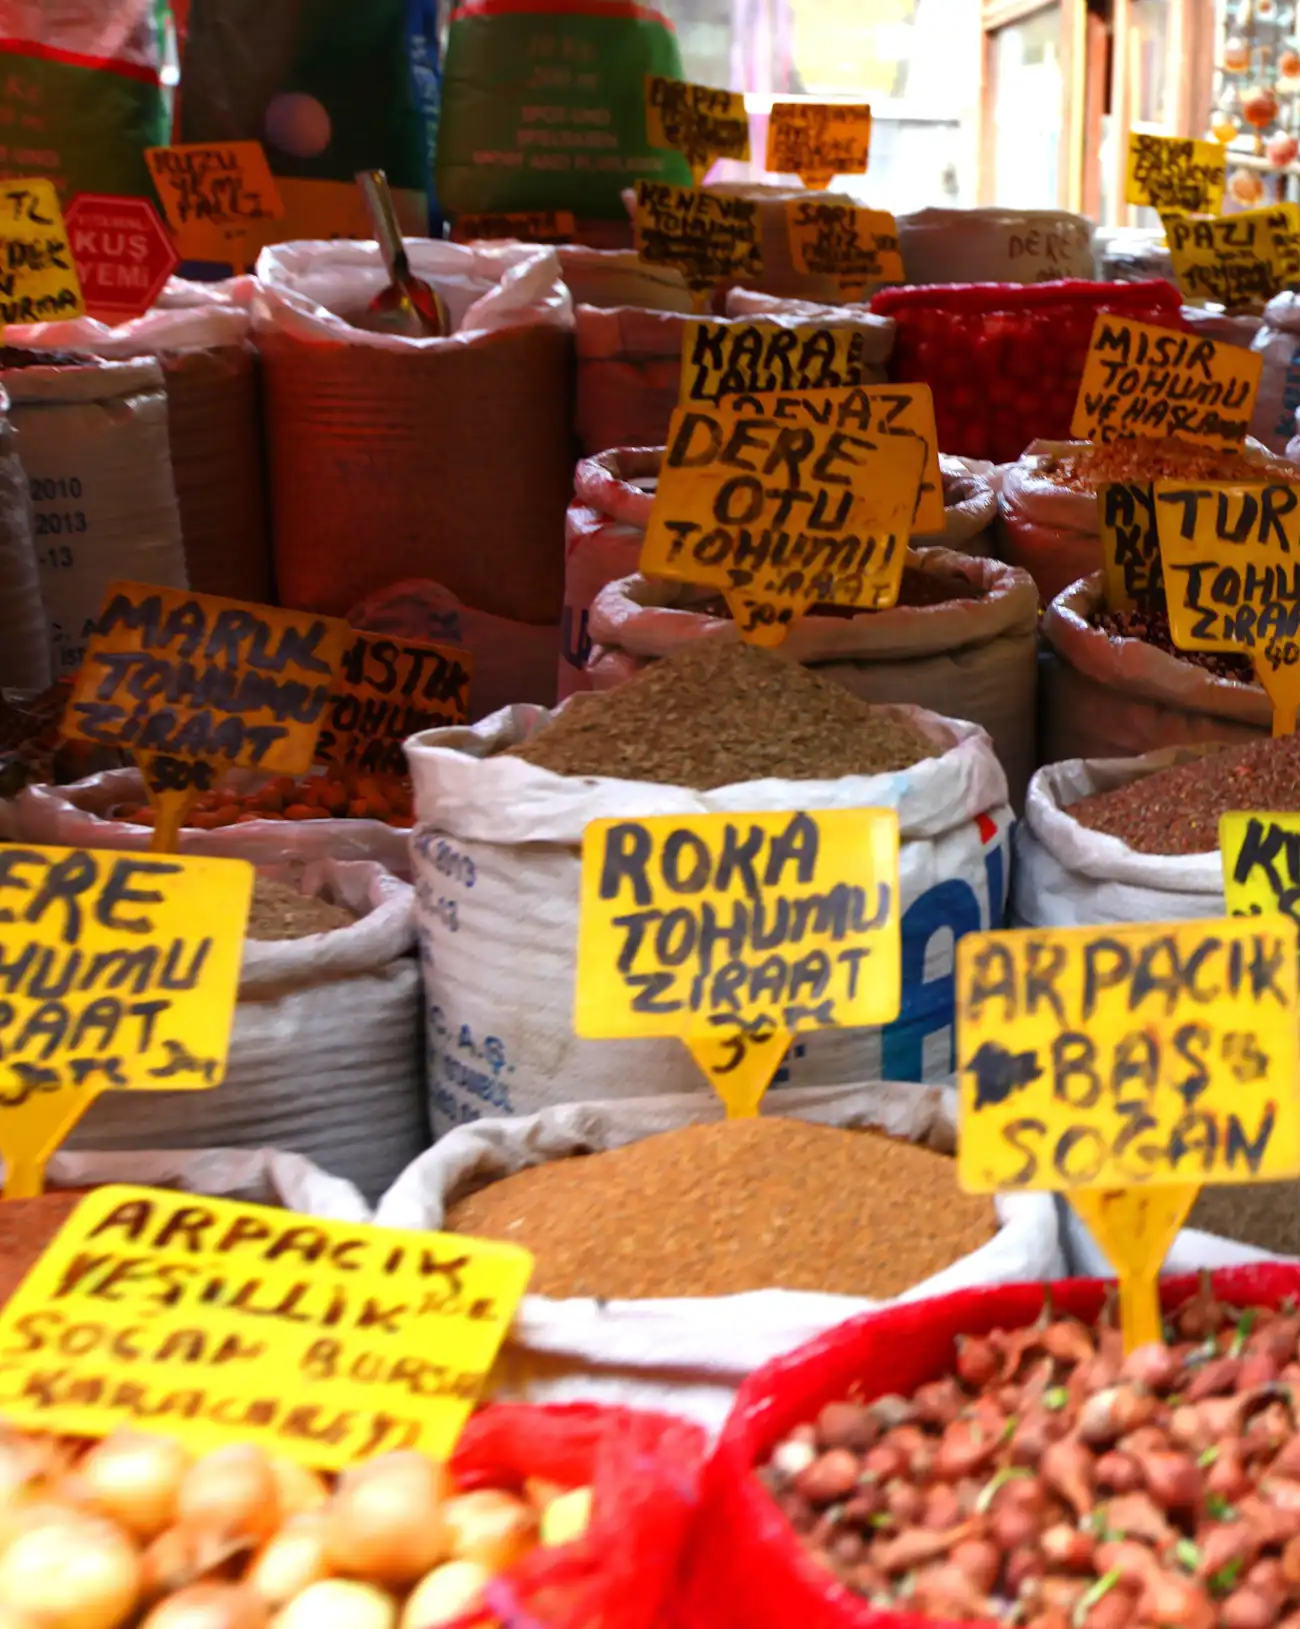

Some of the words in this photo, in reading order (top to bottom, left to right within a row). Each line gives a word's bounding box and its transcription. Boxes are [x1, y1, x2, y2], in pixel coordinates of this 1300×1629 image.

[74, 230, 149, 263] KUŞ
[1094, 325, 1217, 380] MISIR
[1100, 358, 1250, 408] TOHUMU
[667, 411, 878, 492] DERE
[712, 475, 853, 533] OTU
[598, 810, 820, 906] ROKA
[612, 880, 893, 975] TOHUMU
[965, 933, 1291, 1023] ARPACIK
[0, 998, 171, 1060] AAT
[1050, 1021, 1212, 1109] BAŞ
[86, 1198, 470, 1296] ARPACIK
